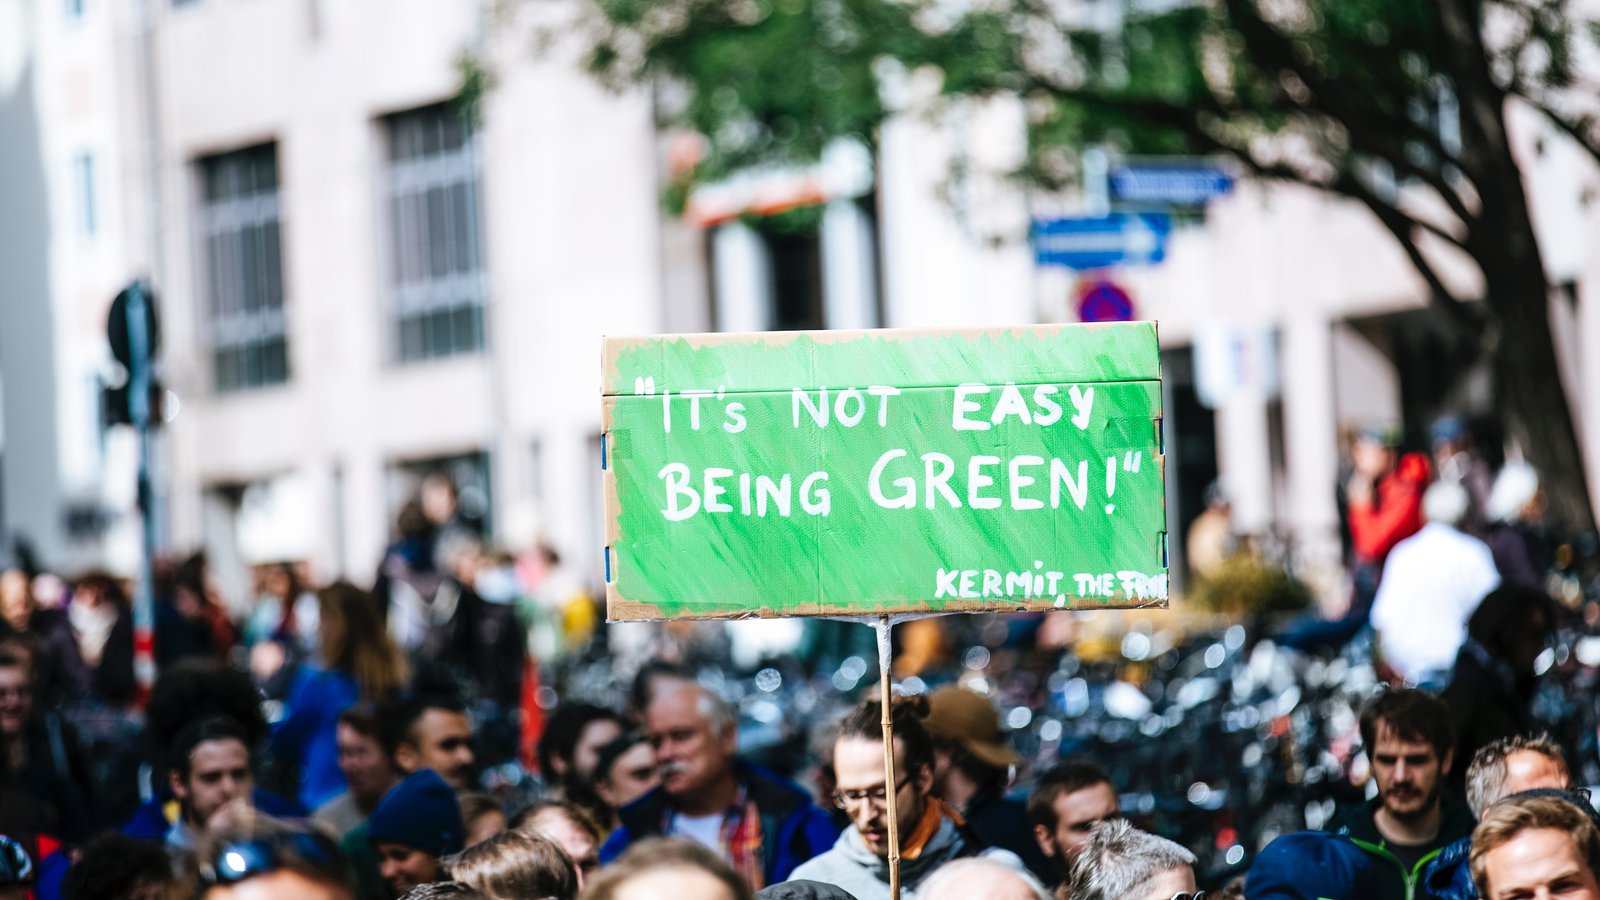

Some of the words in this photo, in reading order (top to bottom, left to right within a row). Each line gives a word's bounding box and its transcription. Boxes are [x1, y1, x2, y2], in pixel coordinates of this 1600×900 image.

[791, 386, 903, 428] NOT
[952, 382, 1096, 431] EASY
[658, 462, 831, 521] BEING
[1073, 573, 1115, 597] THE
